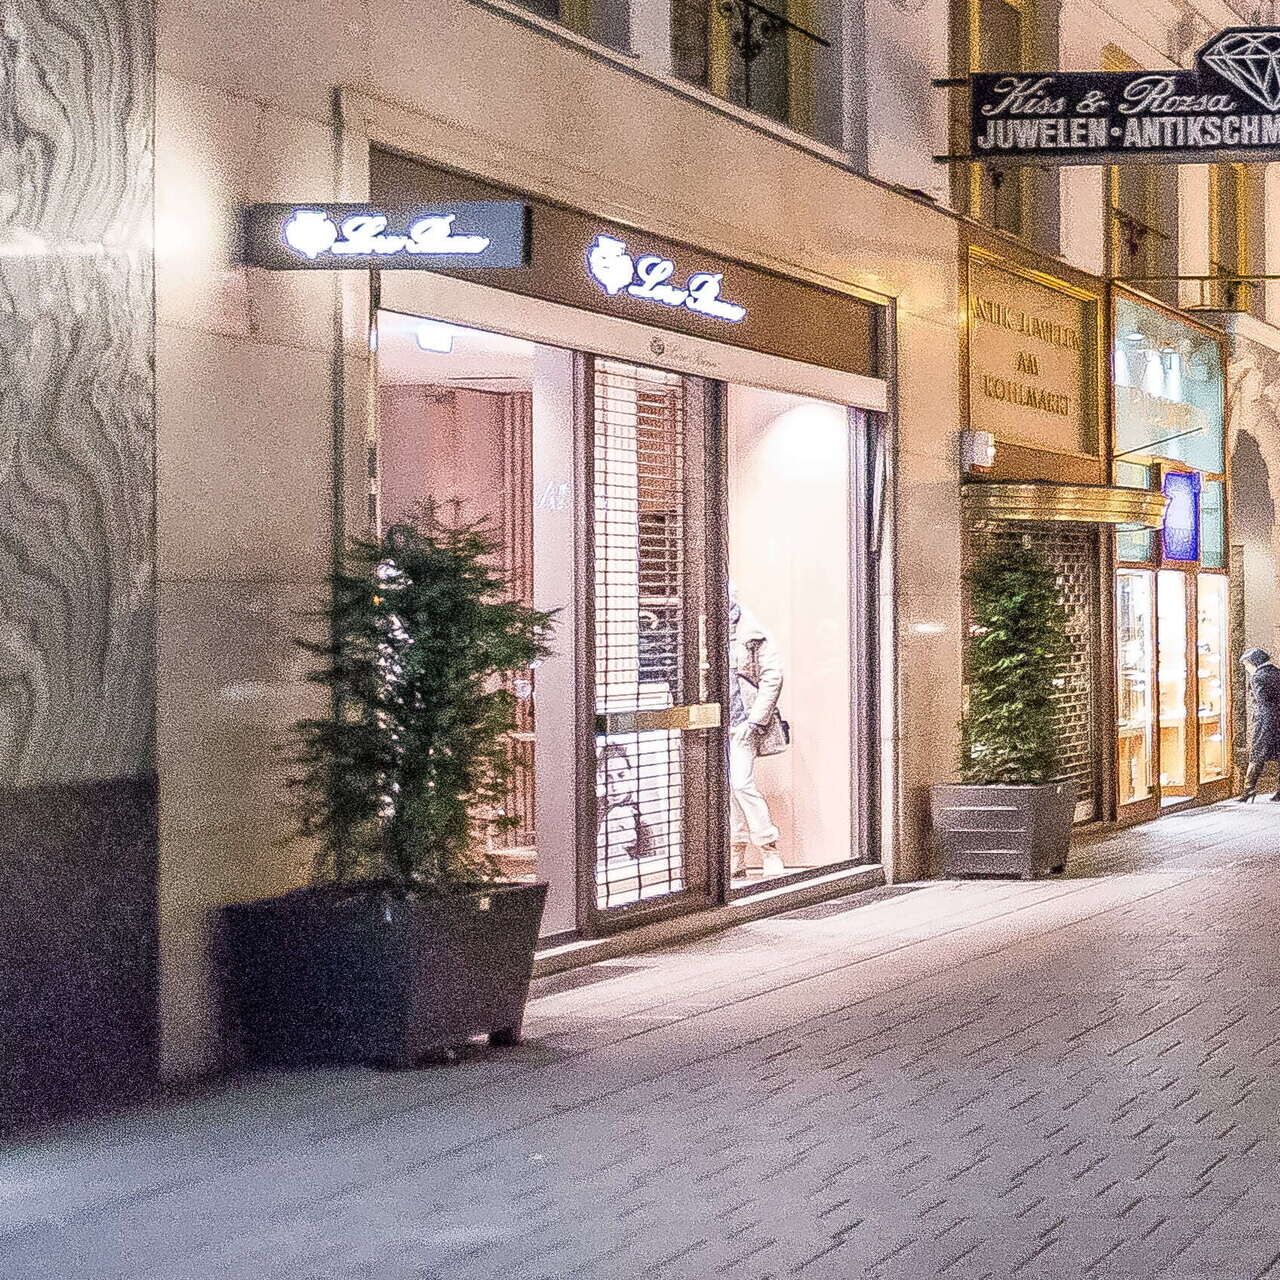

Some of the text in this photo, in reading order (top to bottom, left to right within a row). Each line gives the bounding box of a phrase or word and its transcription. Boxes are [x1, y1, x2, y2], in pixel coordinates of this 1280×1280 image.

[981, 75, 1238, 116] Kiss & Rozsa
[977, 117, 1111, 150] JUWELEN
